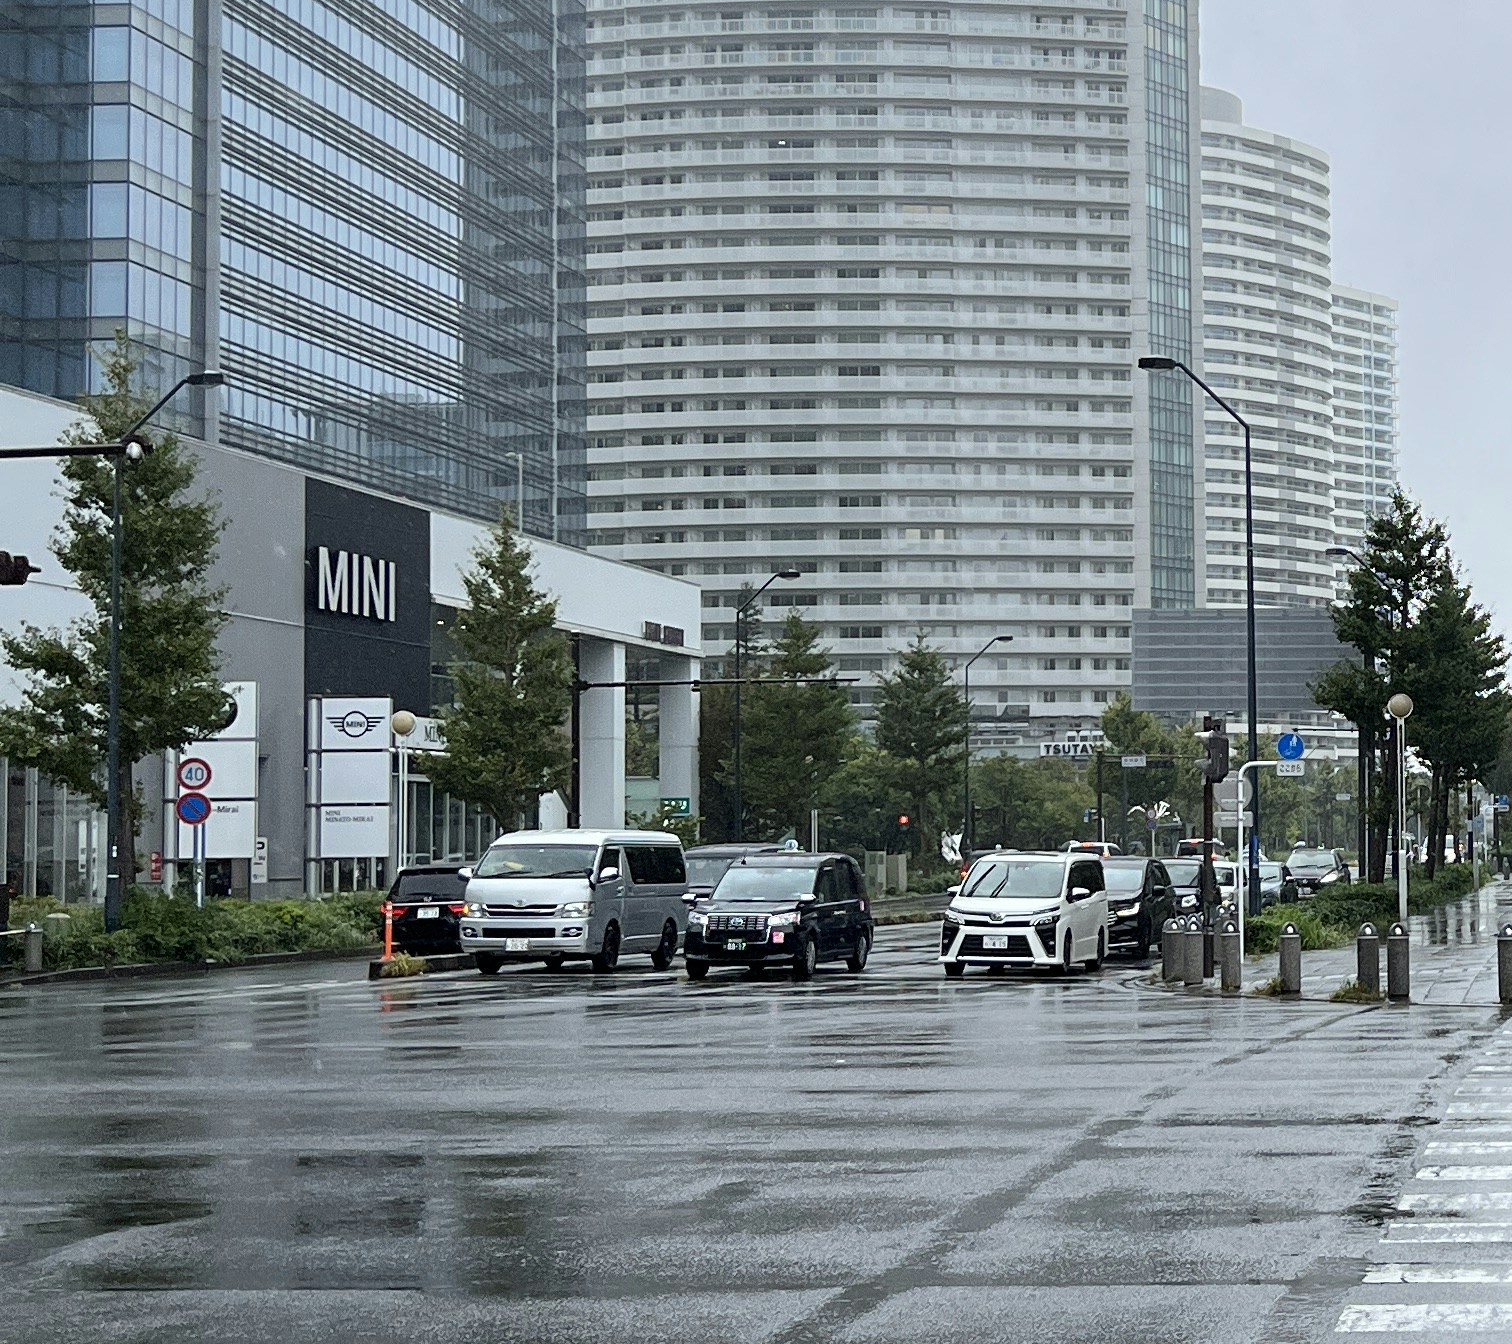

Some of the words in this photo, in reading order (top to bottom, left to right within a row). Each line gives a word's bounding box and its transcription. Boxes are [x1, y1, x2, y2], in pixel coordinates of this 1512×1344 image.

[318, 546, 396, 622] MINI
[345, 720, 366, 728] MINI
[184, 766, 204, 782] 40
[1279, 763, 1301, 773] ここから
